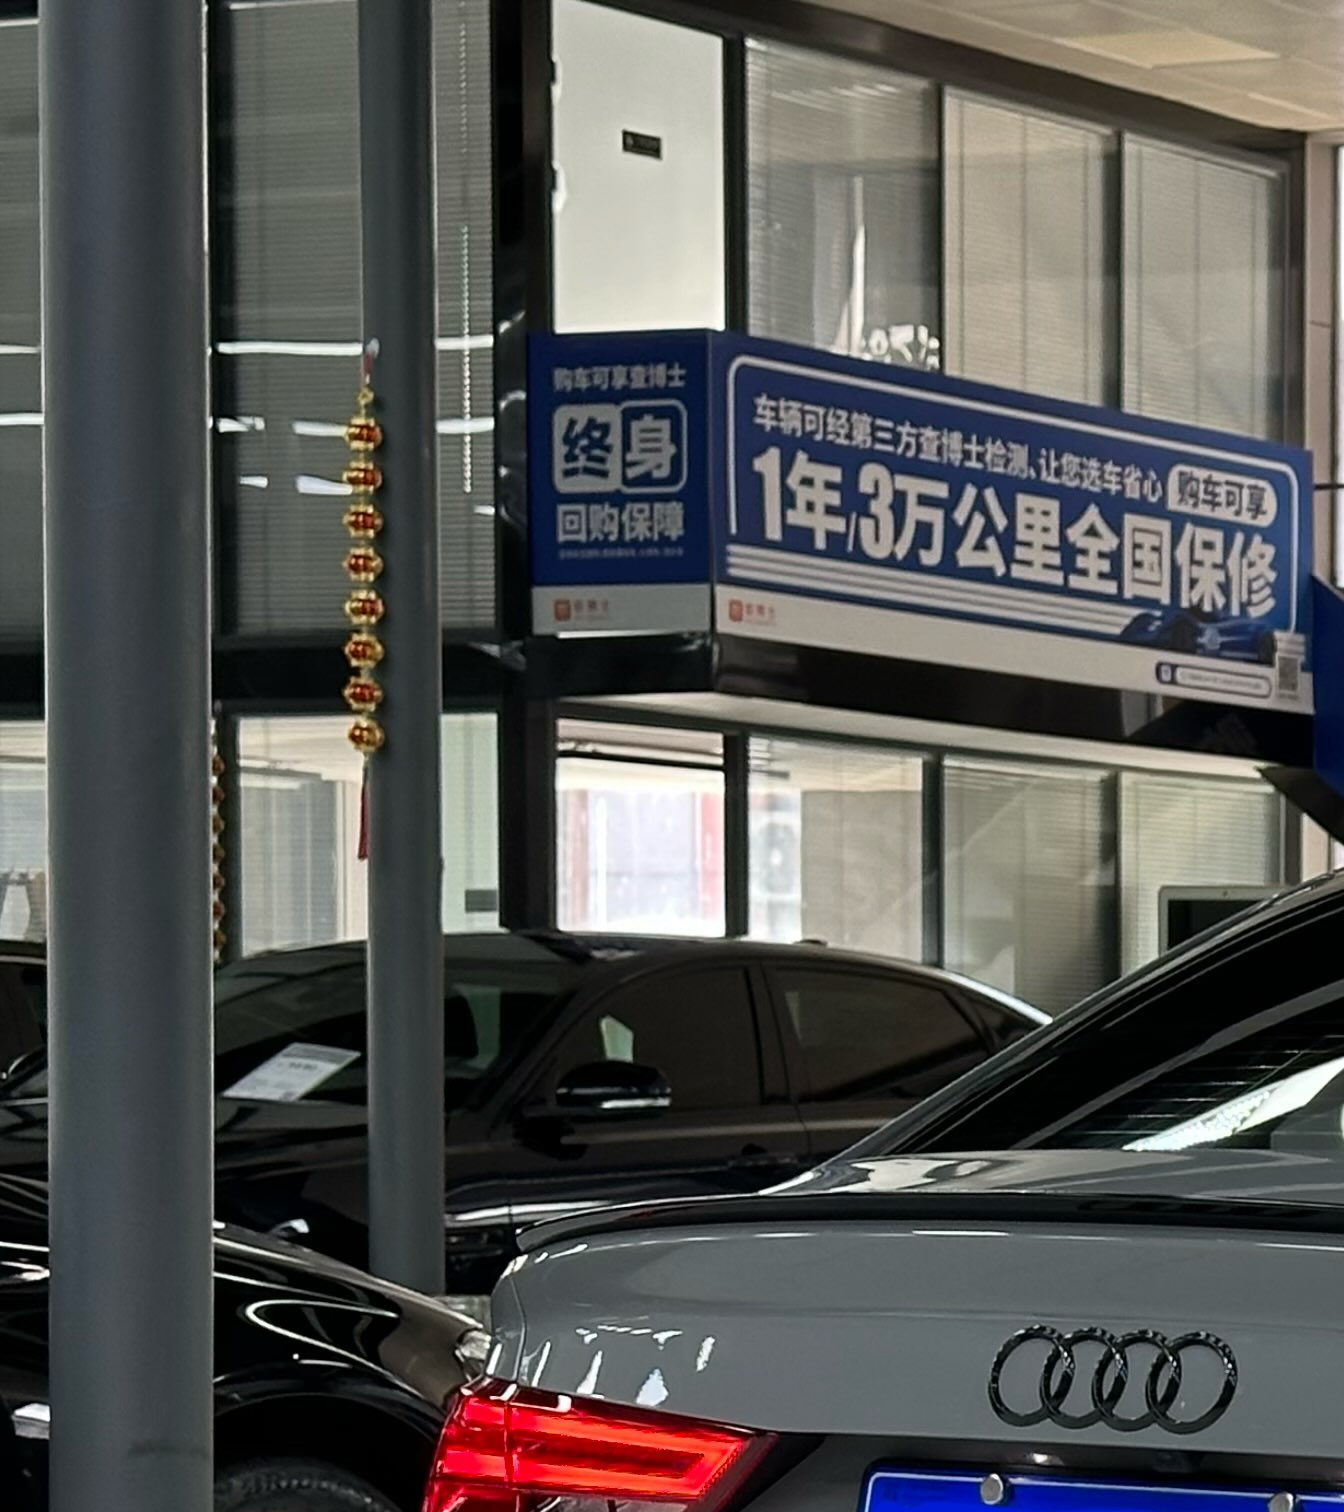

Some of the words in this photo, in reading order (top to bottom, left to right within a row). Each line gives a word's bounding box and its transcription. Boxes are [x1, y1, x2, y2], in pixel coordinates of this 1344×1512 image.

[553, 362, 687, 392] 购车可享查博士
[559, 410, 679, 482] 终身
[1177, 469, 1268, 521] 购车可享
[556, 502, 686, 544] 回购保障
[752, 445, 1279, 618] 1年/3万公里全国保修
